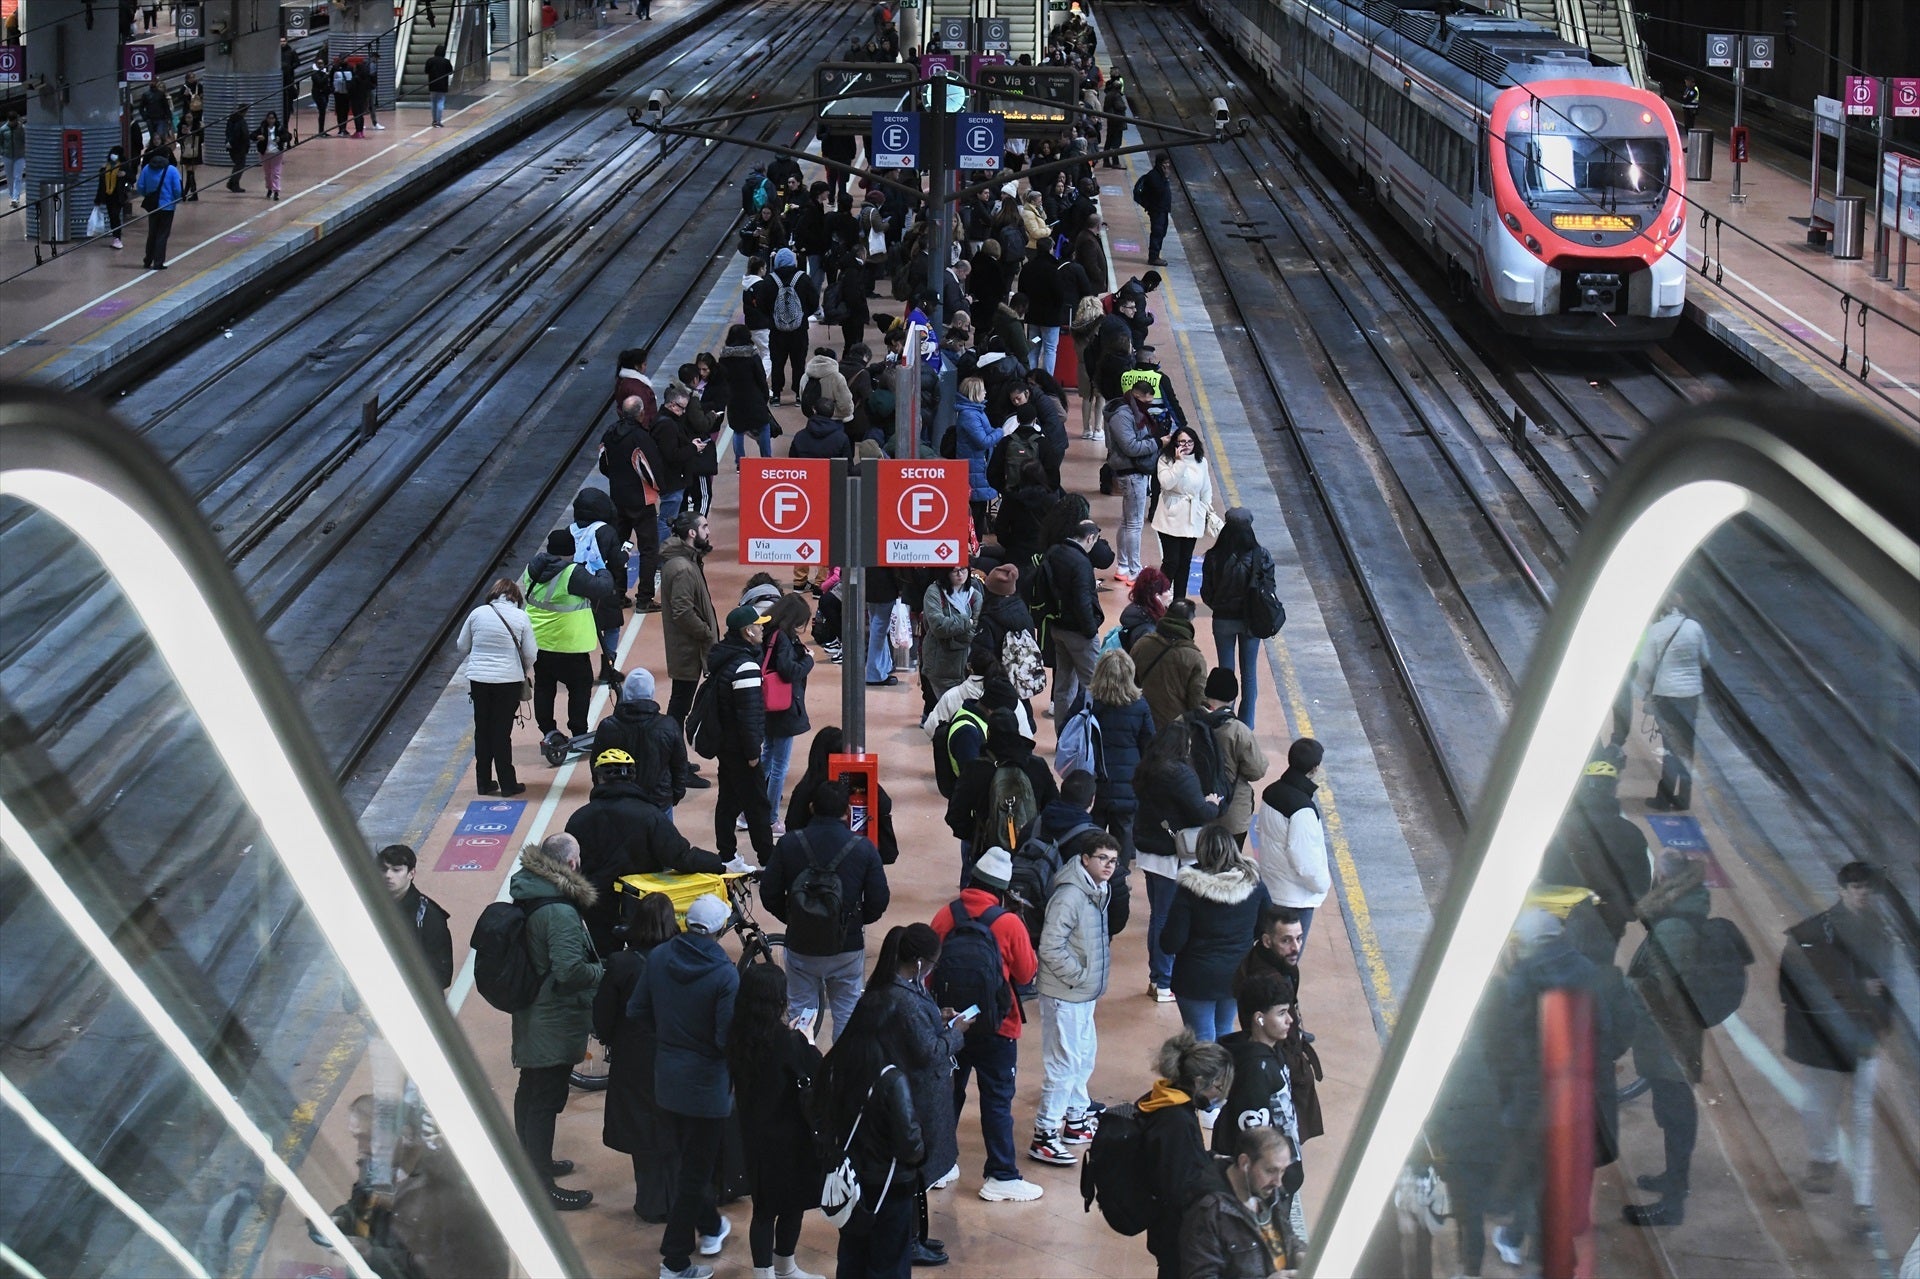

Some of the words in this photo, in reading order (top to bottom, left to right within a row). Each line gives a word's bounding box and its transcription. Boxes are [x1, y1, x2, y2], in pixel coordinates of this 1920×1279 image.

[949, 26, 959, 37] C
[991, 26, 1001, 37] C
[1715, 43, 1725, 55] C
[1756, 45, 1766, 56] C
[134, 54, 145, 67] D
[1029, 76, 1036, 86] 3
[1857, 88, 1868, 101] D
[889, 129, 902, 147] E
[974, 130, 986, 148] E
[761, 469, 807, 480] SECTOR
[901, 468, 945, 479] SECTOR
[774, 491, 798, 524] F
[912, 492, 933, 525] F
[754, 550, 792, 562] Platform
[801, 545, 809, 557] 4
[893, 552, 930, 562] Platform
[939, 545, 948, 558] 3
